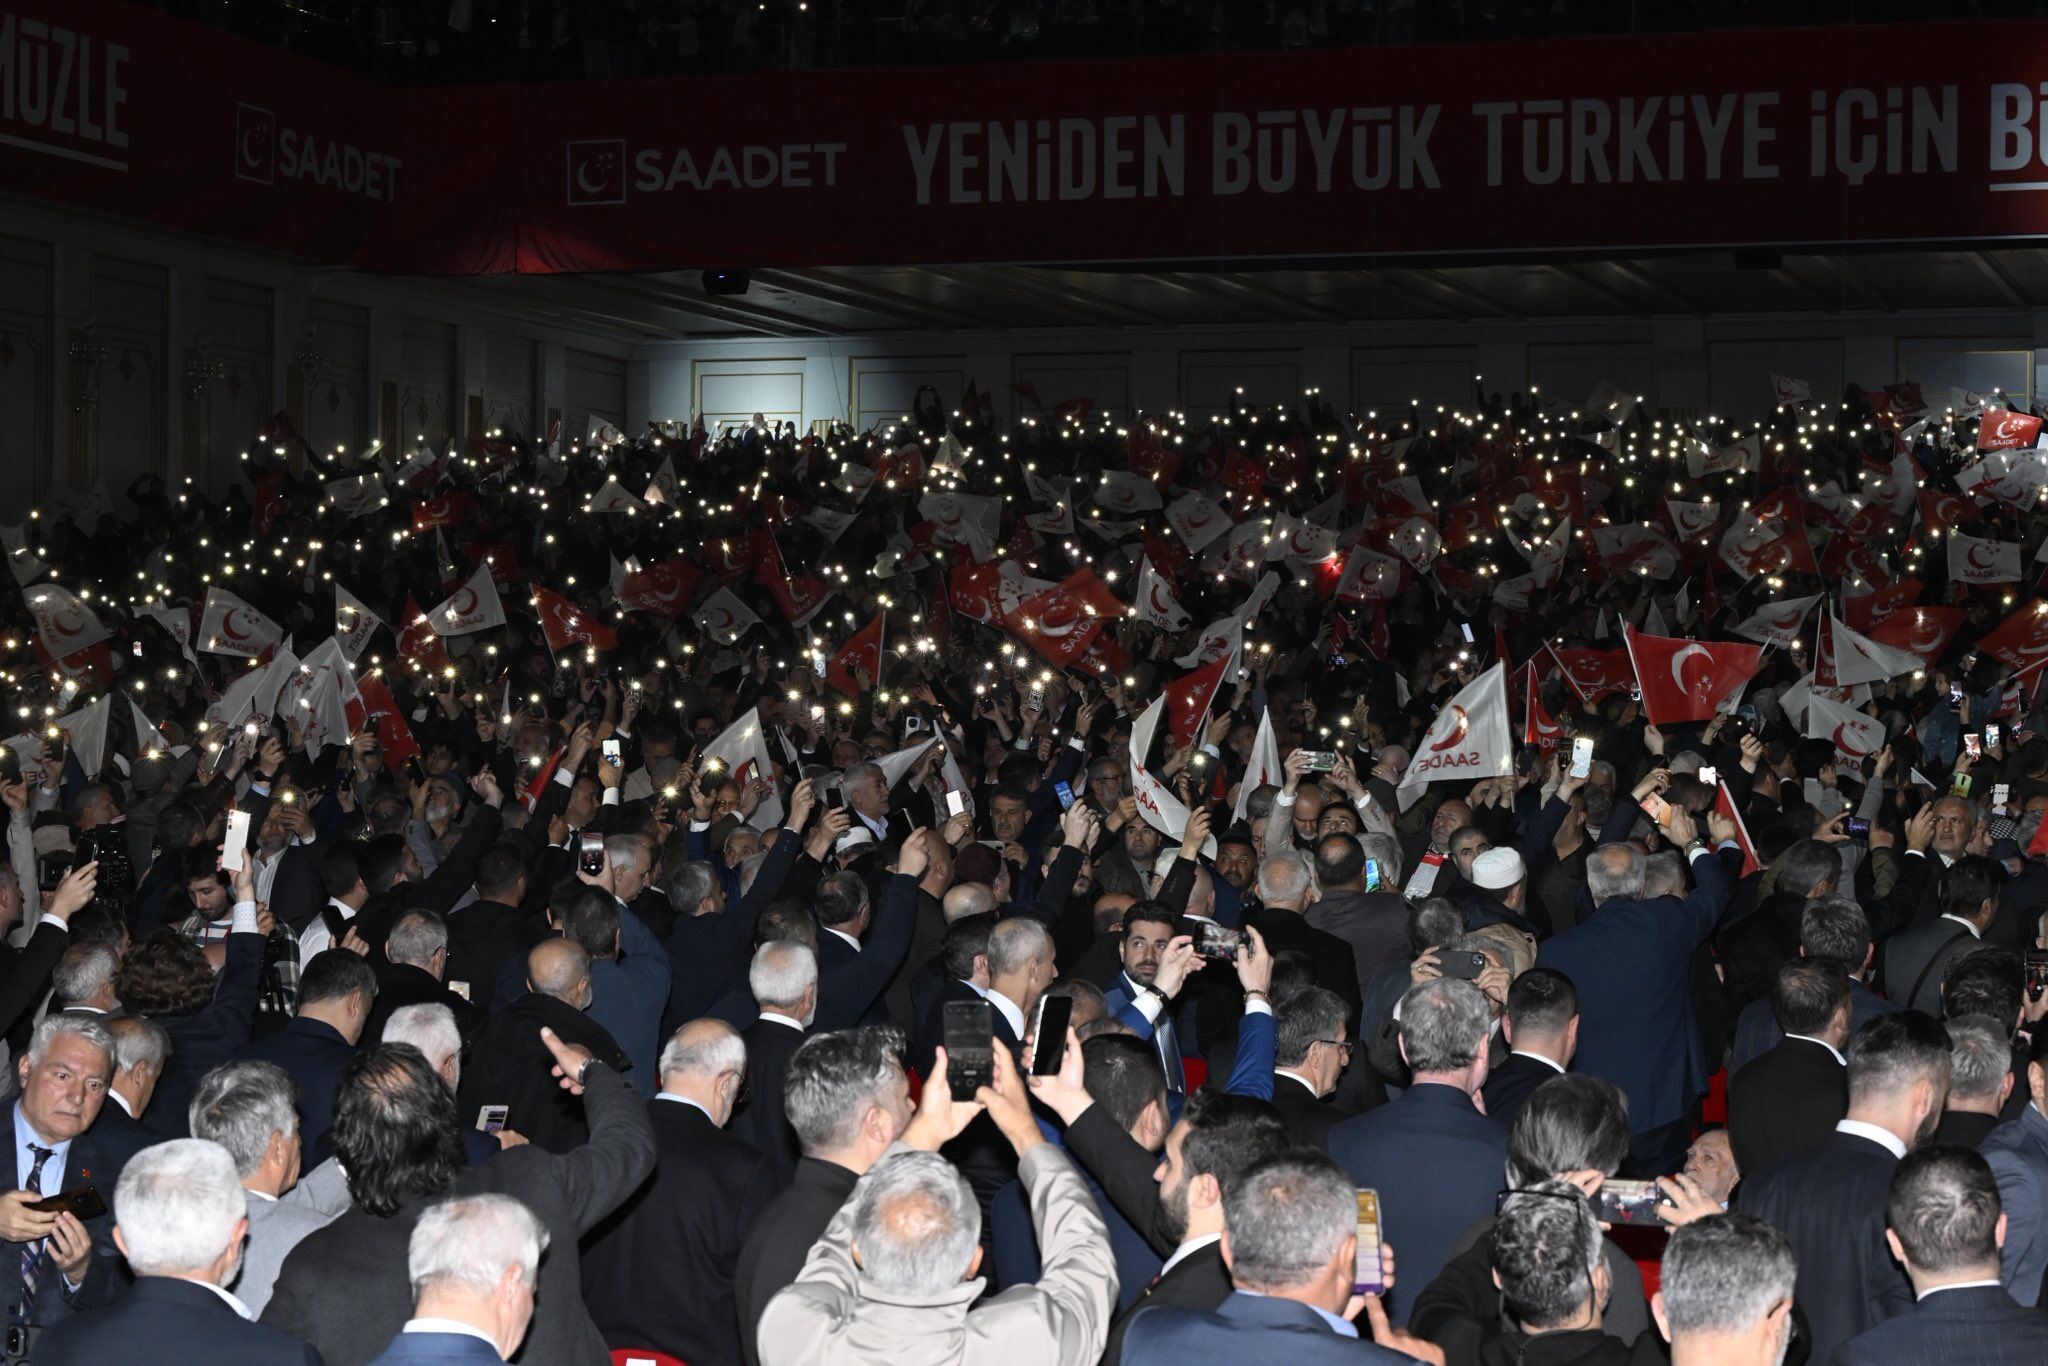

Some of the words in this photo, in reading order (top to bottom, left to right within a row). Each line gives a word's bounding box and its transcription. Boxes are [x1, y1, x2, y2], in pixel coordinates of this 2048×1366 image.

[902, 114, 1185, 205] YENİDEN
[1212, 104, 1442, 195] BÜYÜK
[1472, 91, 1780, 187] TÜRKİYE
[1811, 85, 1958, 186] İÇİN
[1990, 82, 2048, 171] B
[279, 128, 402, 202] SAADET
[634, 142, 847, 192] SAADET
[1992, 438, 2018, 447] SAADET
[214, 637, 258, 654] SAADET
[1133, 785, 1161, 818] SAA
